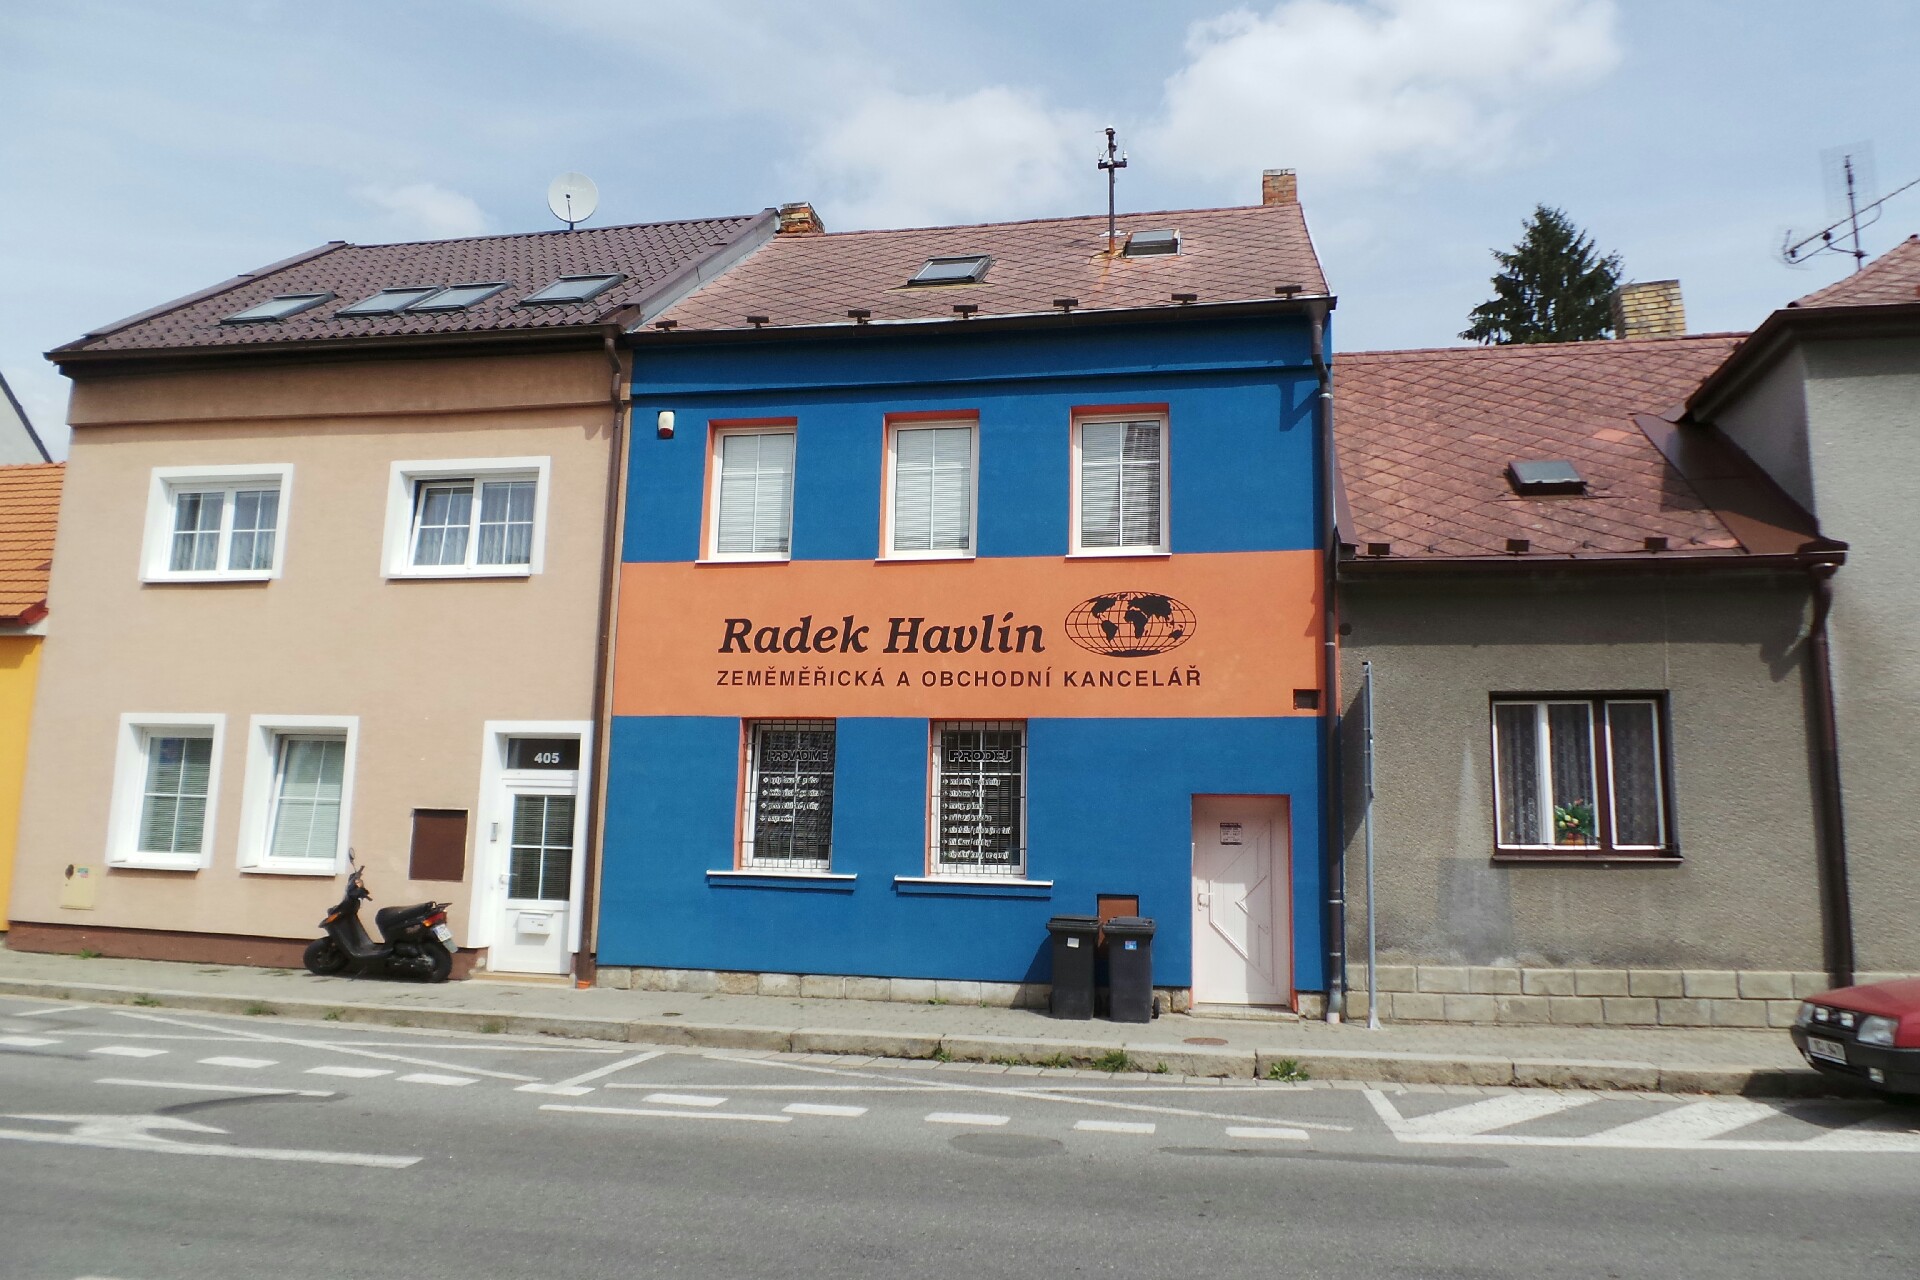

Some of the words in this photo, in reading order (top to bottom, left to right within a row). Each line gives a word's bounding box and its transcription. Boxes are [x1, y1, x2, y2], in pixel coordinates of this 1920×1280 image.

[717, 615, 869, 653] Radek
[882, 611, 1046, 654] Havlín
[716, 665, 886, 687] ZEMĚMĚŘICKÁ
[896, 670, 911, 687] A
[921, 666, 1051, 688] OBCHODNÍ
[1063, 664, 1201, 688] KANCELÁŘ
[534, 752, 560, 764] 405
[948, 749, 1013, 763] PRODEJ
